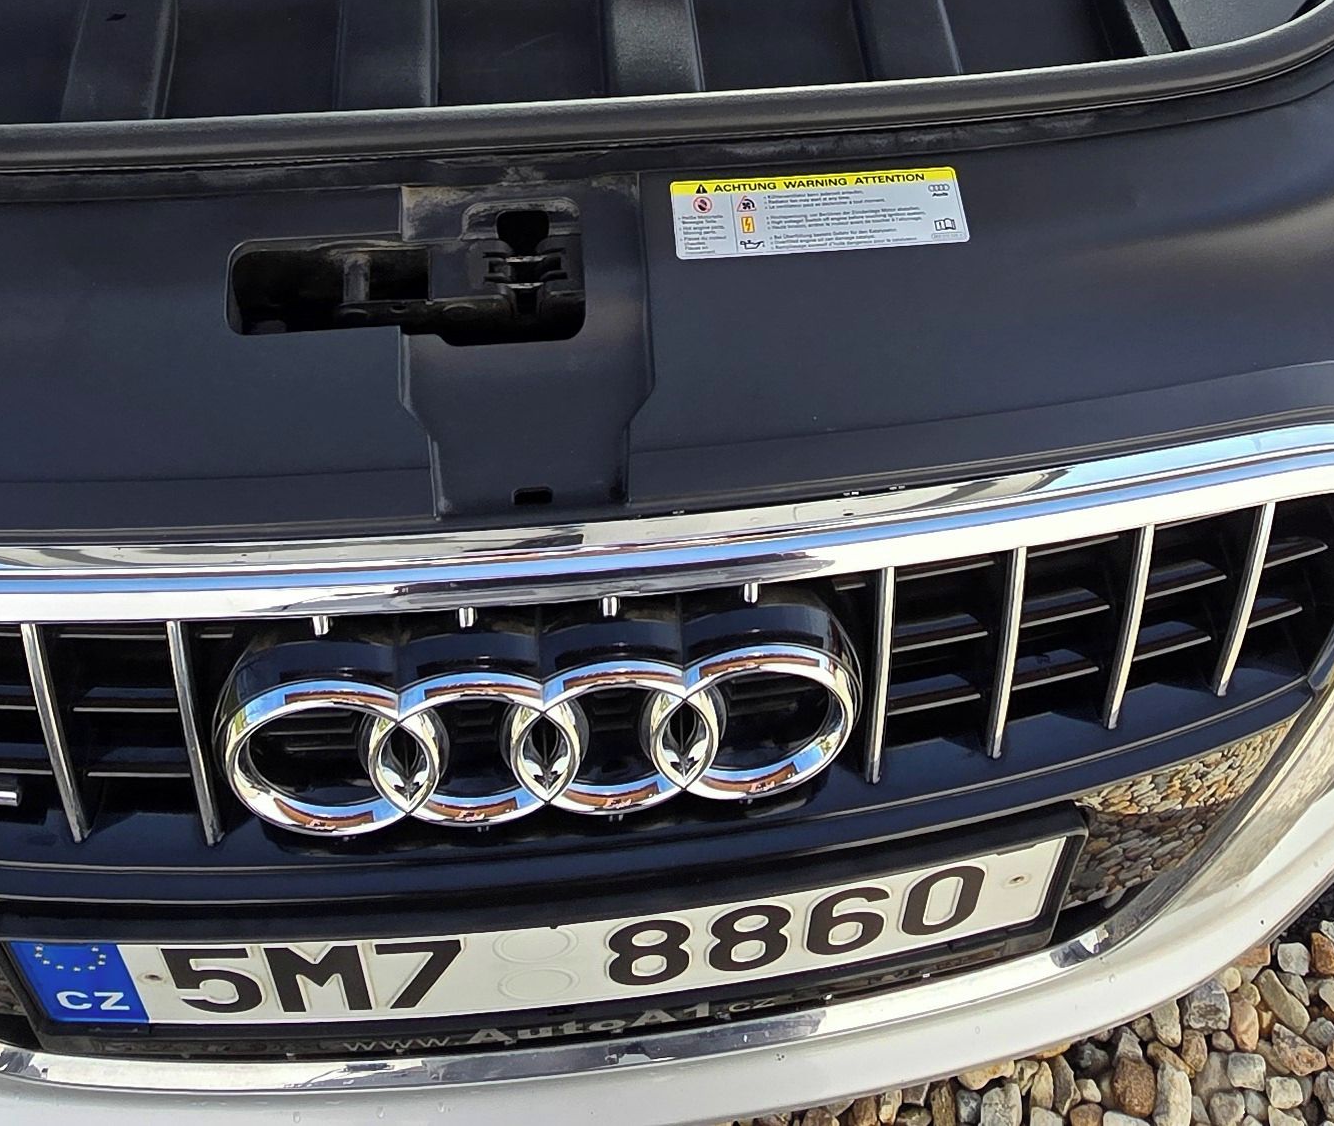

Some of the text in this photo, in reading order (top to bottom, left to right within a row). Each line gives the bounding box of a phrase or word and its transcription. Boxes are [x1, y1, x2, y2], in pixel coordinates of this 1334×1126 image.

[714, 173, 925, 192] ACHTUNG WARNING ATTENTION
[160, 865, 986, 1014] 5M7 8860
[56, 991, 130, 1011] CZ
